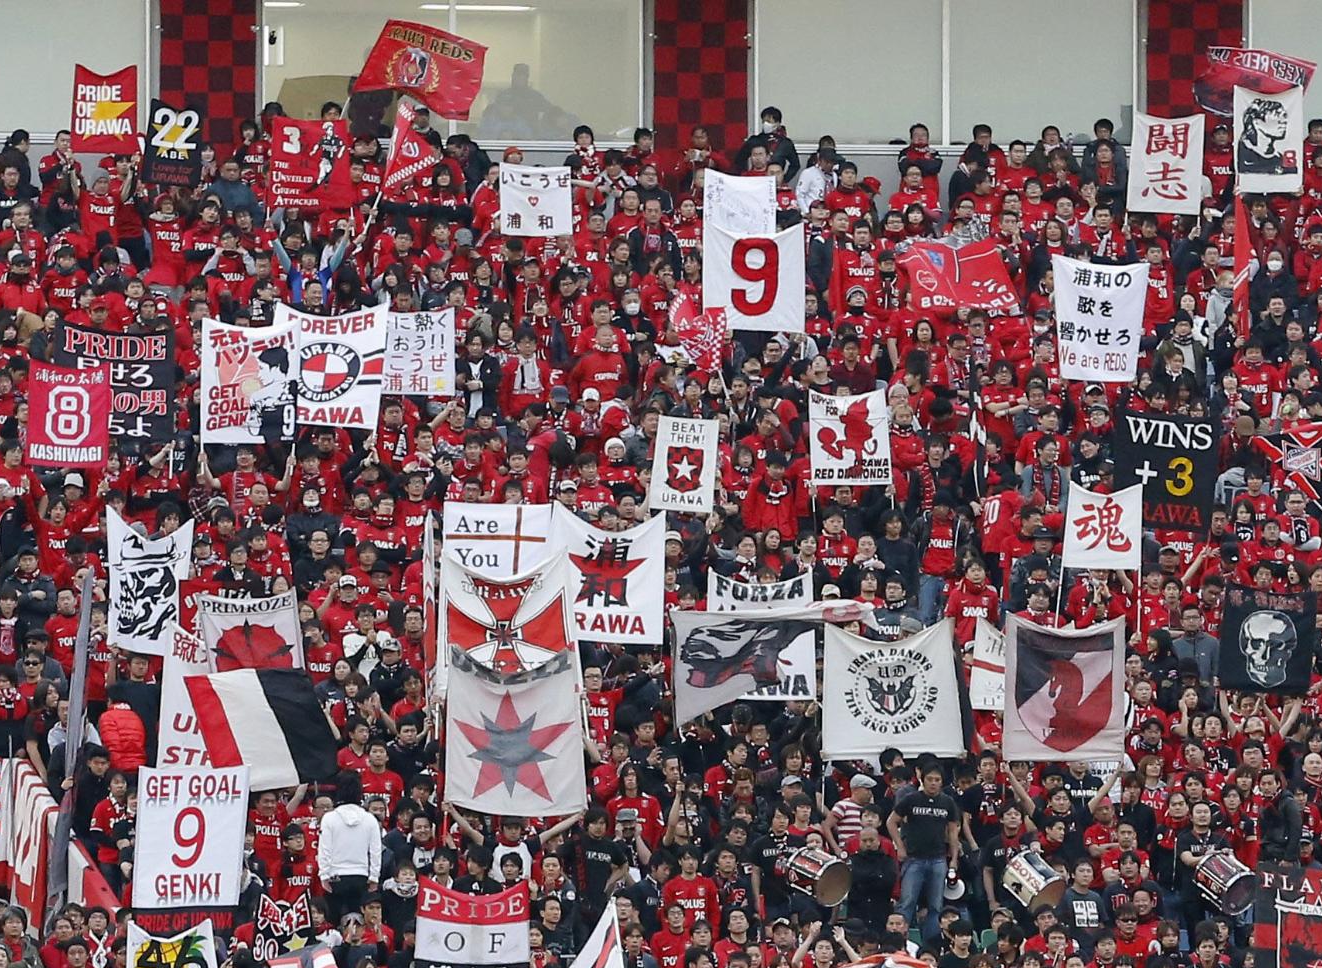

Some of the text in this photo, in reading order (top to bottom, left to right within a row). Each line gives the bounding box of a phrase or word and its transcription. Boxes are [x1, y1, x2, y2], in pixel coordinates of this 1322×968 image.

[429, 36, 475, 62] REDS
[76, 83, 122, 102] PRIDE
[76, 102, 97, 119] OF
[74, 118, 133, 136] URAWA
[150, 107, 199, 150] 22
[280, 126, 300, 155] 3
[159, 151, 186, 161] ABE
[273, 161, 288, 170] THE
[1142, 122, 1190, 201] 闘志
[501, 169, 570, 189] いこうぜ
[506, 212, 554, 232] 浦和
[731, 236, 779, 317] 9
[1073, 267, 1133, 289] 浦和の
[1077, 296, 1115, 318] 歌を
[61, 331, 163, 366] PRIDE
[300, 343, 356, 363] URAWA
[1080, 350, 1129, 372] are REDS
[209, 381, 238, 400] GET
[384, 374, 429, 393] 浦和
[46, 386, 91, 447] 8
[207, 399, 248, 417] GOAL
[671, 420, 705, 433] BEAT
[1125, 413, 1212, 450] WINS
[670, 432, 706, 444] THEM!
[29, 445, 104, 465] KASHIWAGI
[814, 467, 890, 480] RED DIAMONDS
[1165, 456, 1194, 497] 3
[661, 492, 704, 506] URAWA
[454, 514, 499, 535] Are
[1072, 497, 1134, 553] 魂
[454, 546, 500, 569] You
[200, 594, 293, 615] PRIMROZE
[847, 648, 933, 675] URAWA DANDYS
[145, 774, 242, 798] GET GOAL
[173, 807, 206, 869] 9
[155, 872, 221, 899] GENKI
[420, 884, 526, 919] PRIDE
[252, 934, 280, 962] 30
[442, 930, 506, 955] OF
